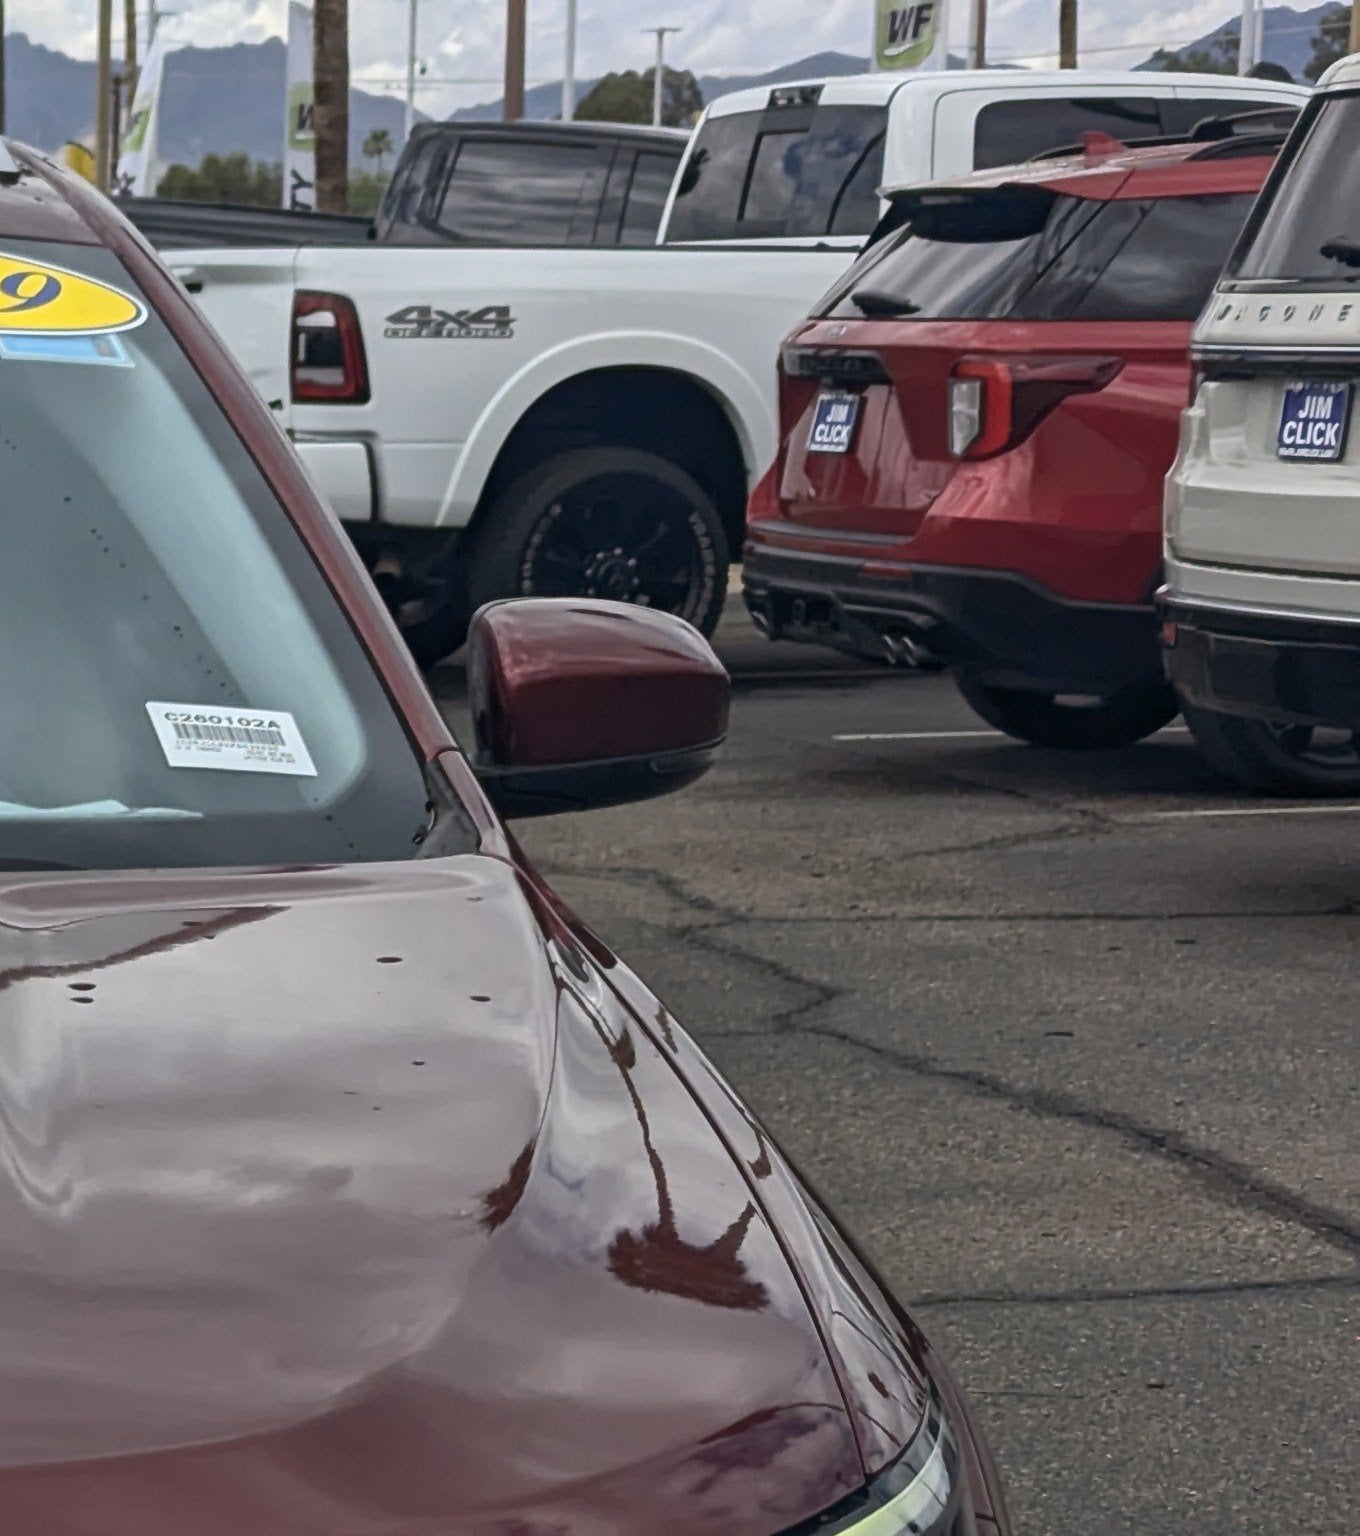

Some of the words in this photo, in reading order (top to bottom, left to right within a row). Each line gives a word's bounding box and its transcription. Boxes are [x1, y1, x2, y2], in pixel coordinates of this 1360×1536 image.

[1298, 396, 1333, 419] JIM
[815, 424, 852, 443] CLICK
[1283, 420, 1340, 446] CLICK
[163, 711, 281, 729] C260102A
